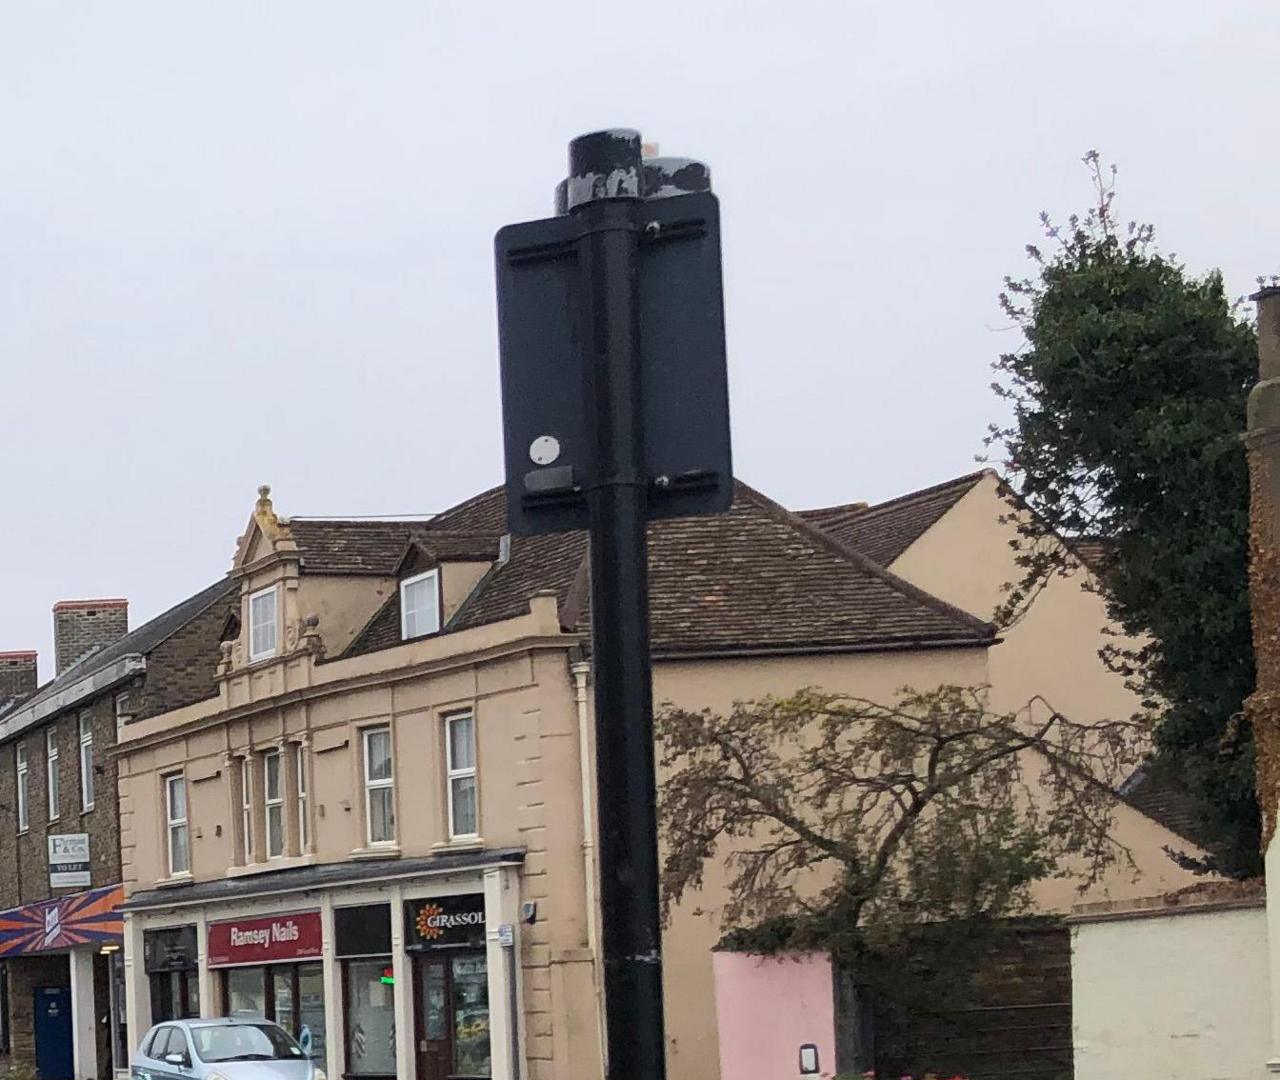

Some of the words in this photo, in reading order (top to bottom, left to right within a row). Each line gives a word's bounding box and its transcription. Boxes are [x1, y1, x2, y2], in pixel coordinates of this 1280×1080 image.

[427, 912, 486, 928] GIRASSOL
[230, 927, 271, 948] Ramsey
[272, 921, 299, 942] Nails
